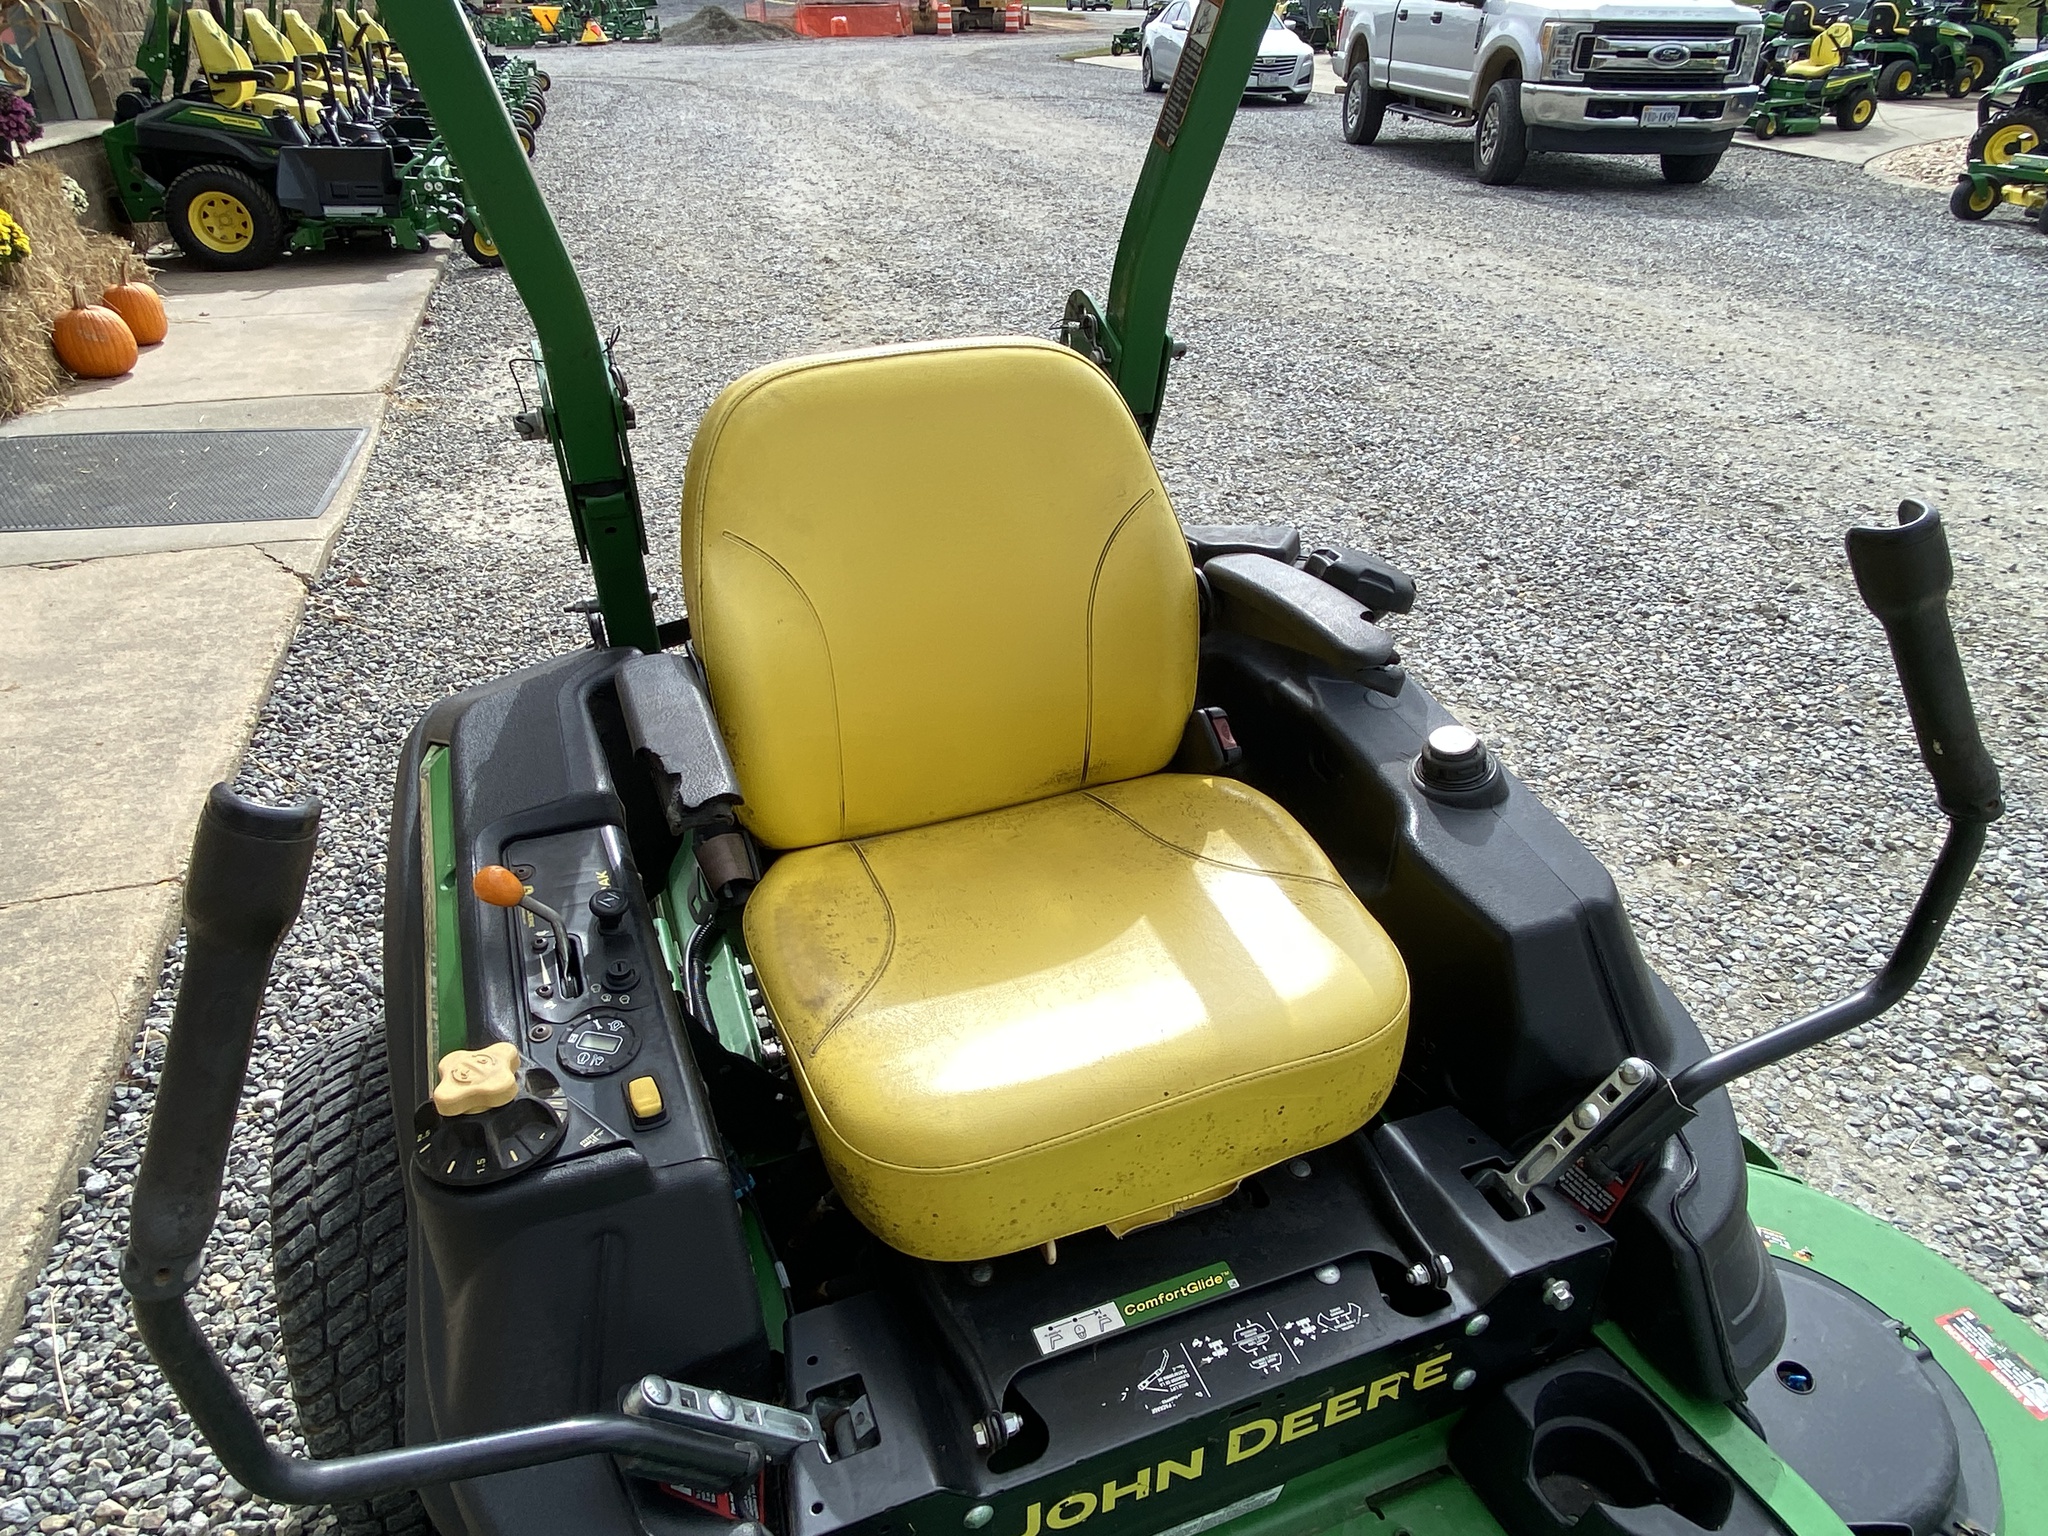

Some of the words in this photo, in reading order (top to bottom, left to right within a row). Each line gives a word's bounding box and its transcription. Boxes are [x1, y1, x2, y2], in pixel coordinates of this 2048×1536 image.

[476, 1157, 487, 1174] 1.5
[1021, 1447, 1205, 1536] JOHN
[1226, 1352, 1452, 1465] DEERE
